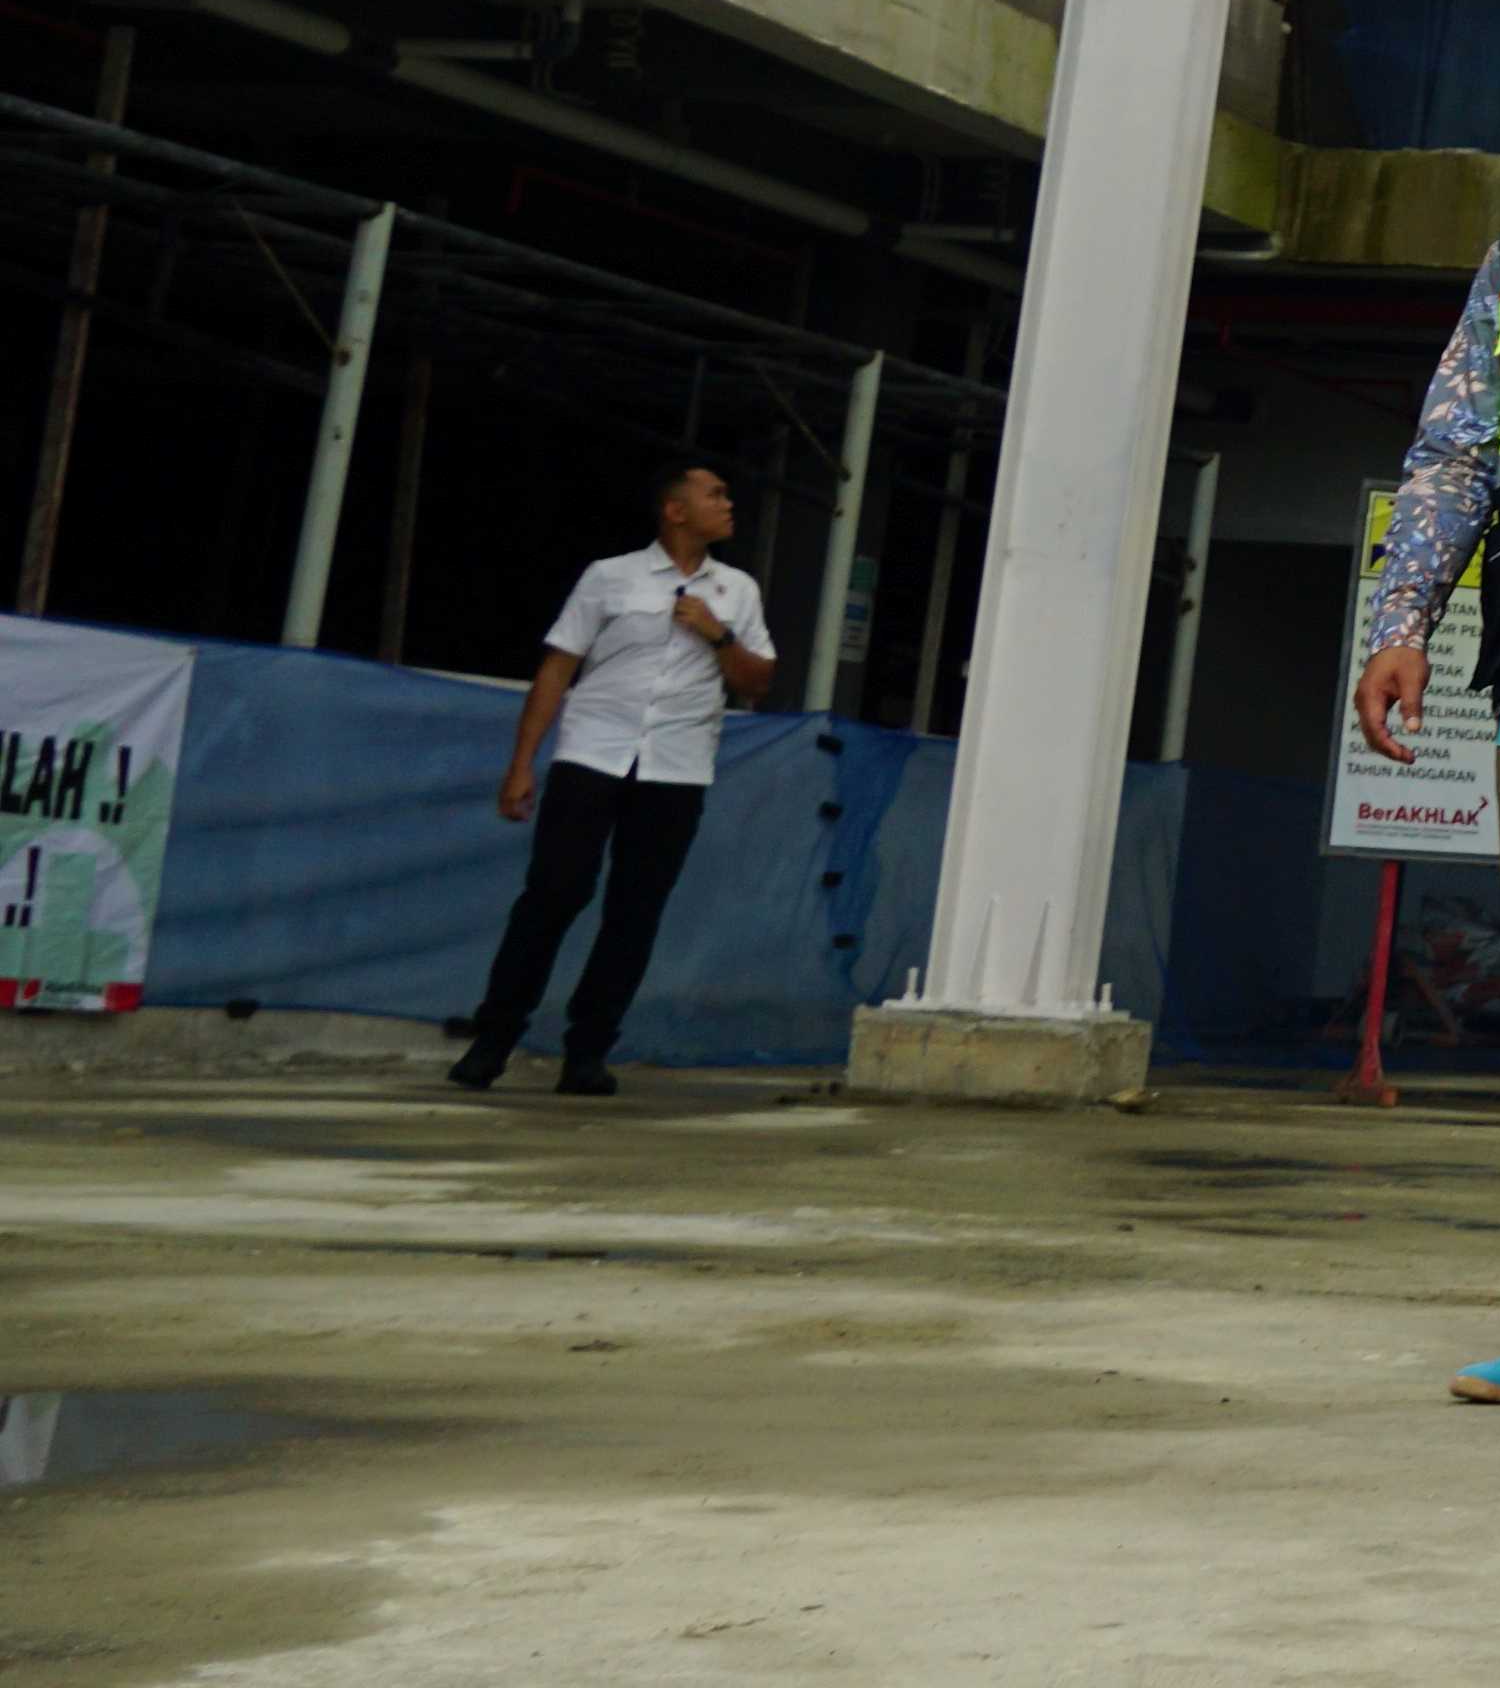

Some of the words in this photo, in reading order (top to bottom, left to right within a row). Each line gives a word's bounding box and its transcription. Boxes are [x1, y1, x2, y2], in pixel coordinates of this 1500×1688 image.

[0, 730, 95, 821] LAH
[1347, 763, 1392, 777] TAHUN
[1396, 766, 1477, 783] ANGGARAN
[1358, 800, 1482, 827] BerAKHLAK
